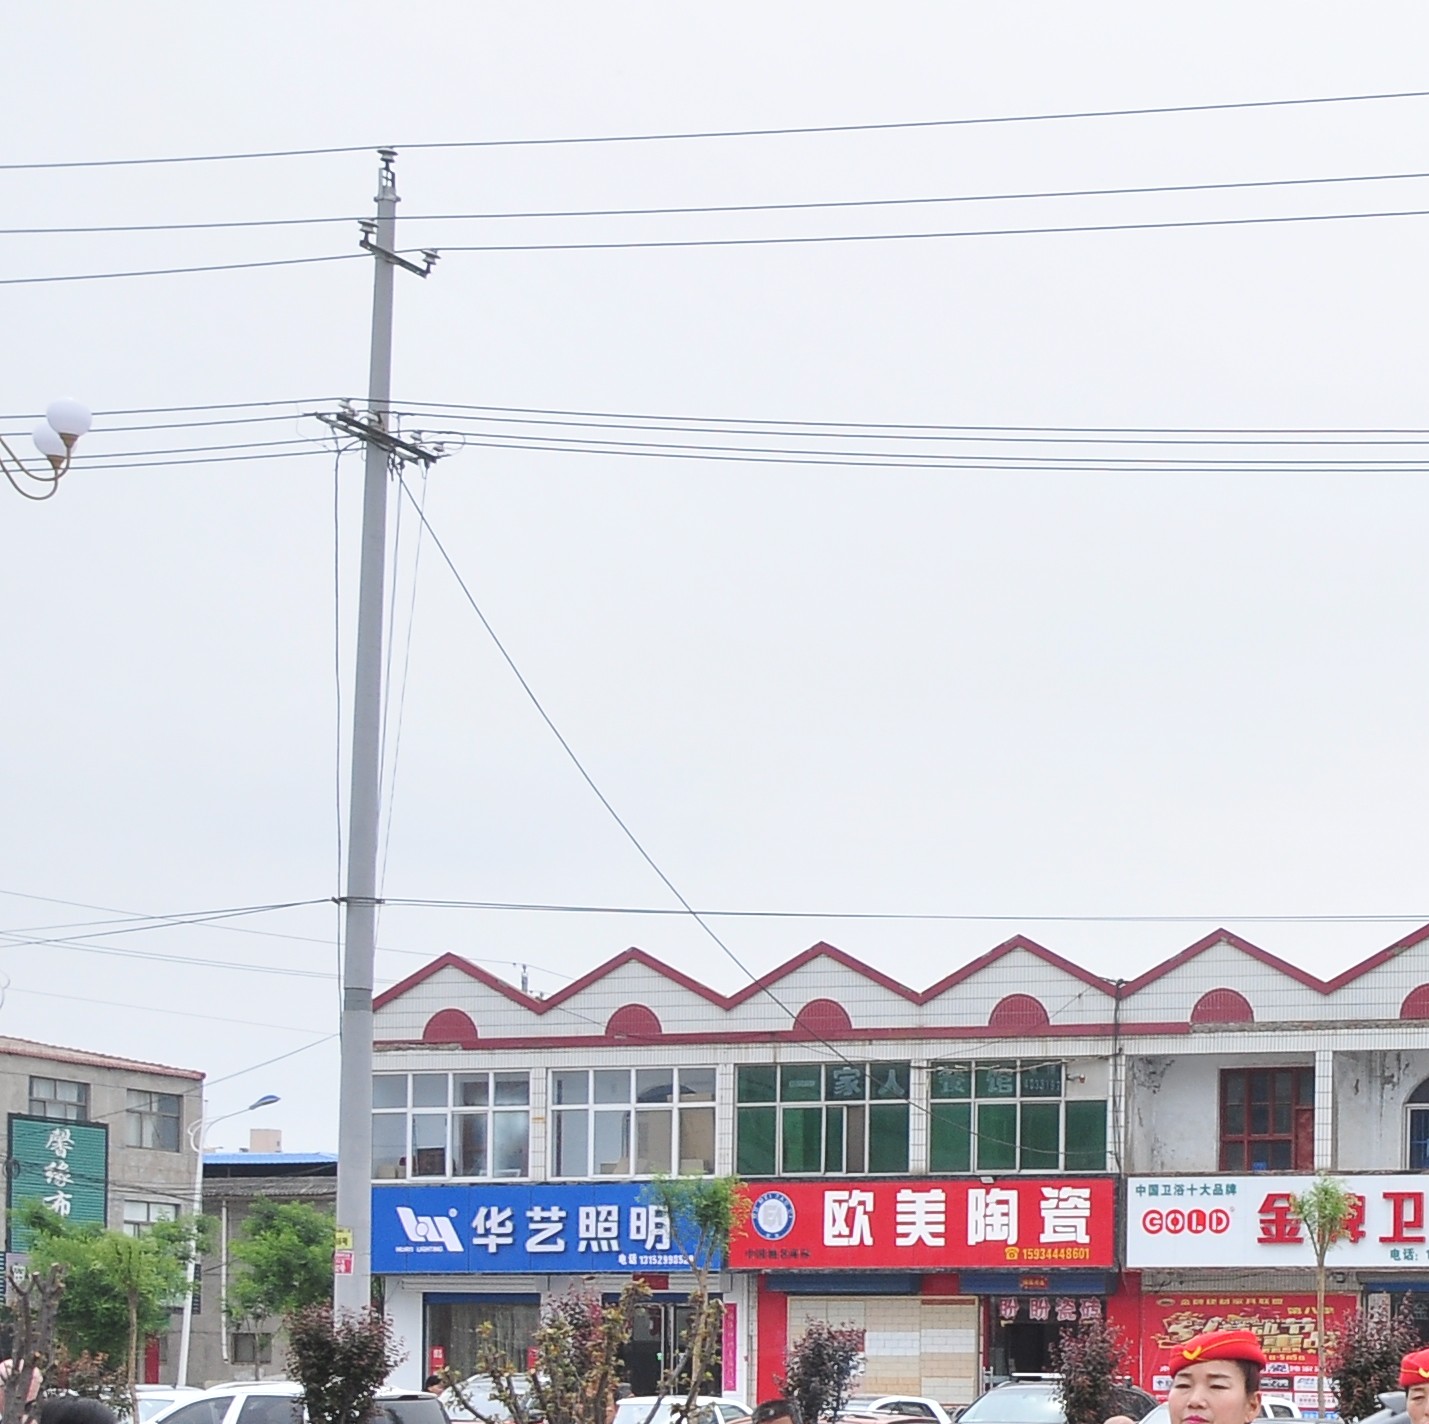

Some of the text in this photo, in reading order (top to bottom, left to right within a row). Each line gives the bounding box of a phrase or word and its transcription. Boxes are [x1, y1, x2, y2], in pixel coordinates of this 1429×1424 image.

[1135, 1183, 1237, 1196] 中国卫浴十大品牌
[471, 1205, 671, 1254] 华艺照明
[823, 1187, 1092, 1247] 欧美陶瓷
[1022, 1248, 1090, 1261] 15934448601
[1000, 1296, 1102, 1321] 盼盼瓷砖
